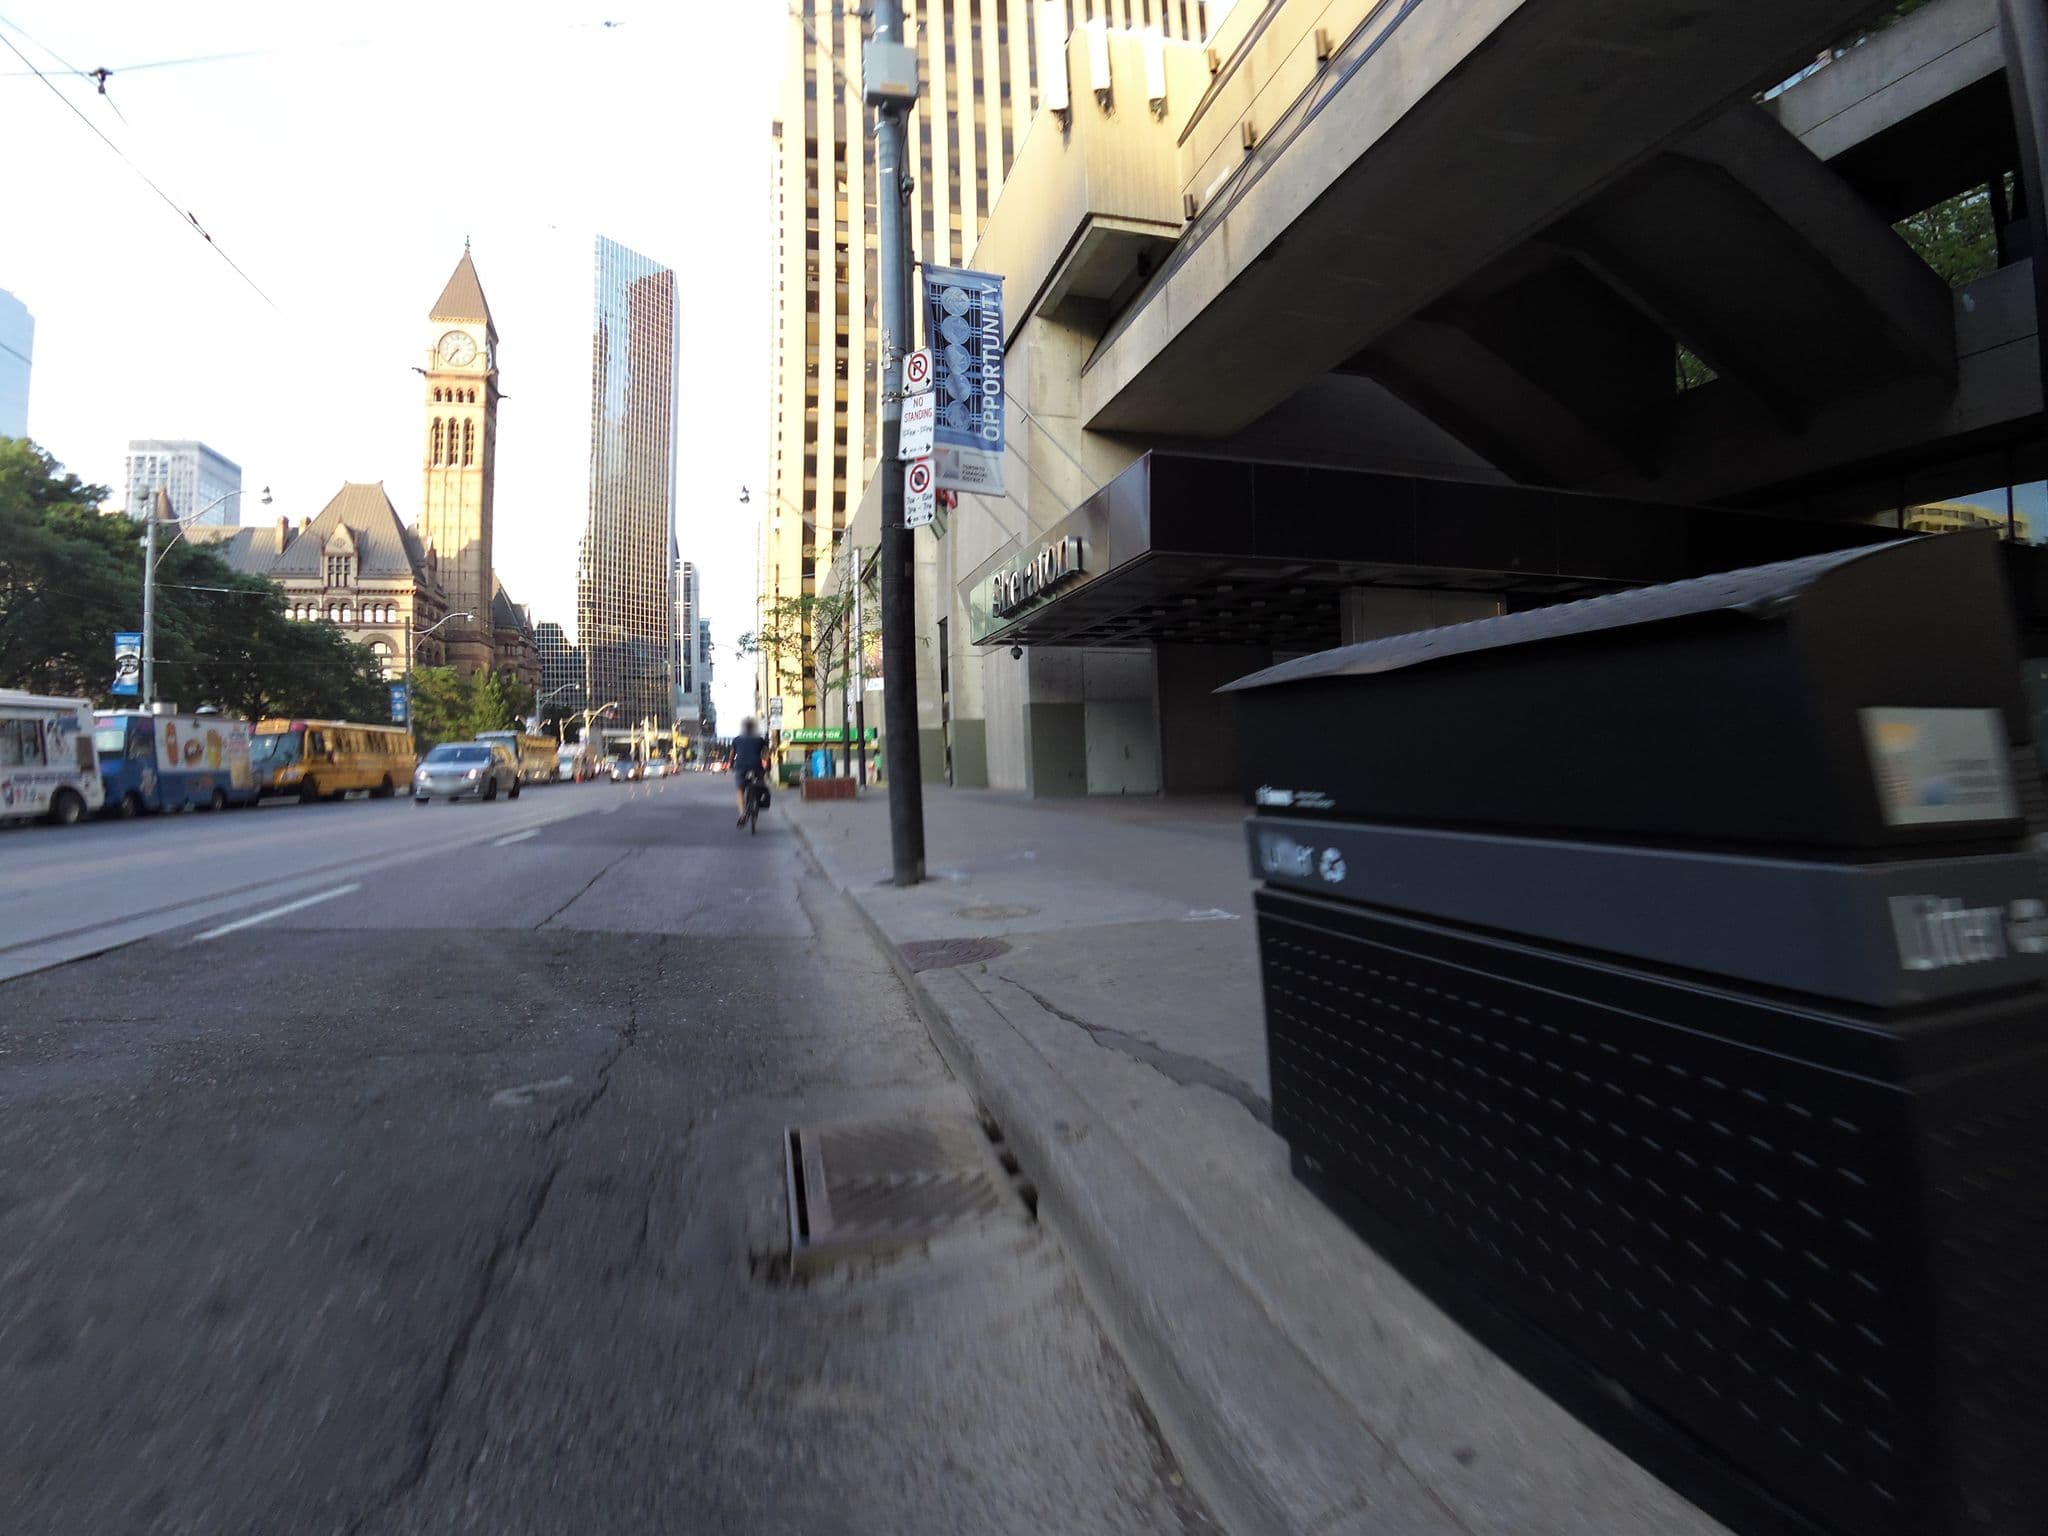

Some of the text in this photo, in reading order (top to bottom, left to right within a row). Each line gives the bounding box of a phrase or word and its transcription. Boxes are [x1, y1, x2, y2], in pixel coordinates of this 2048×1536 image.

[982, 282, 1001, 442] OPPORTUNITY
[903, 408, 933, 423] STANDING
[913, 397, 924, 408] NO
[992, 535, 1083, 618] Sheraton
